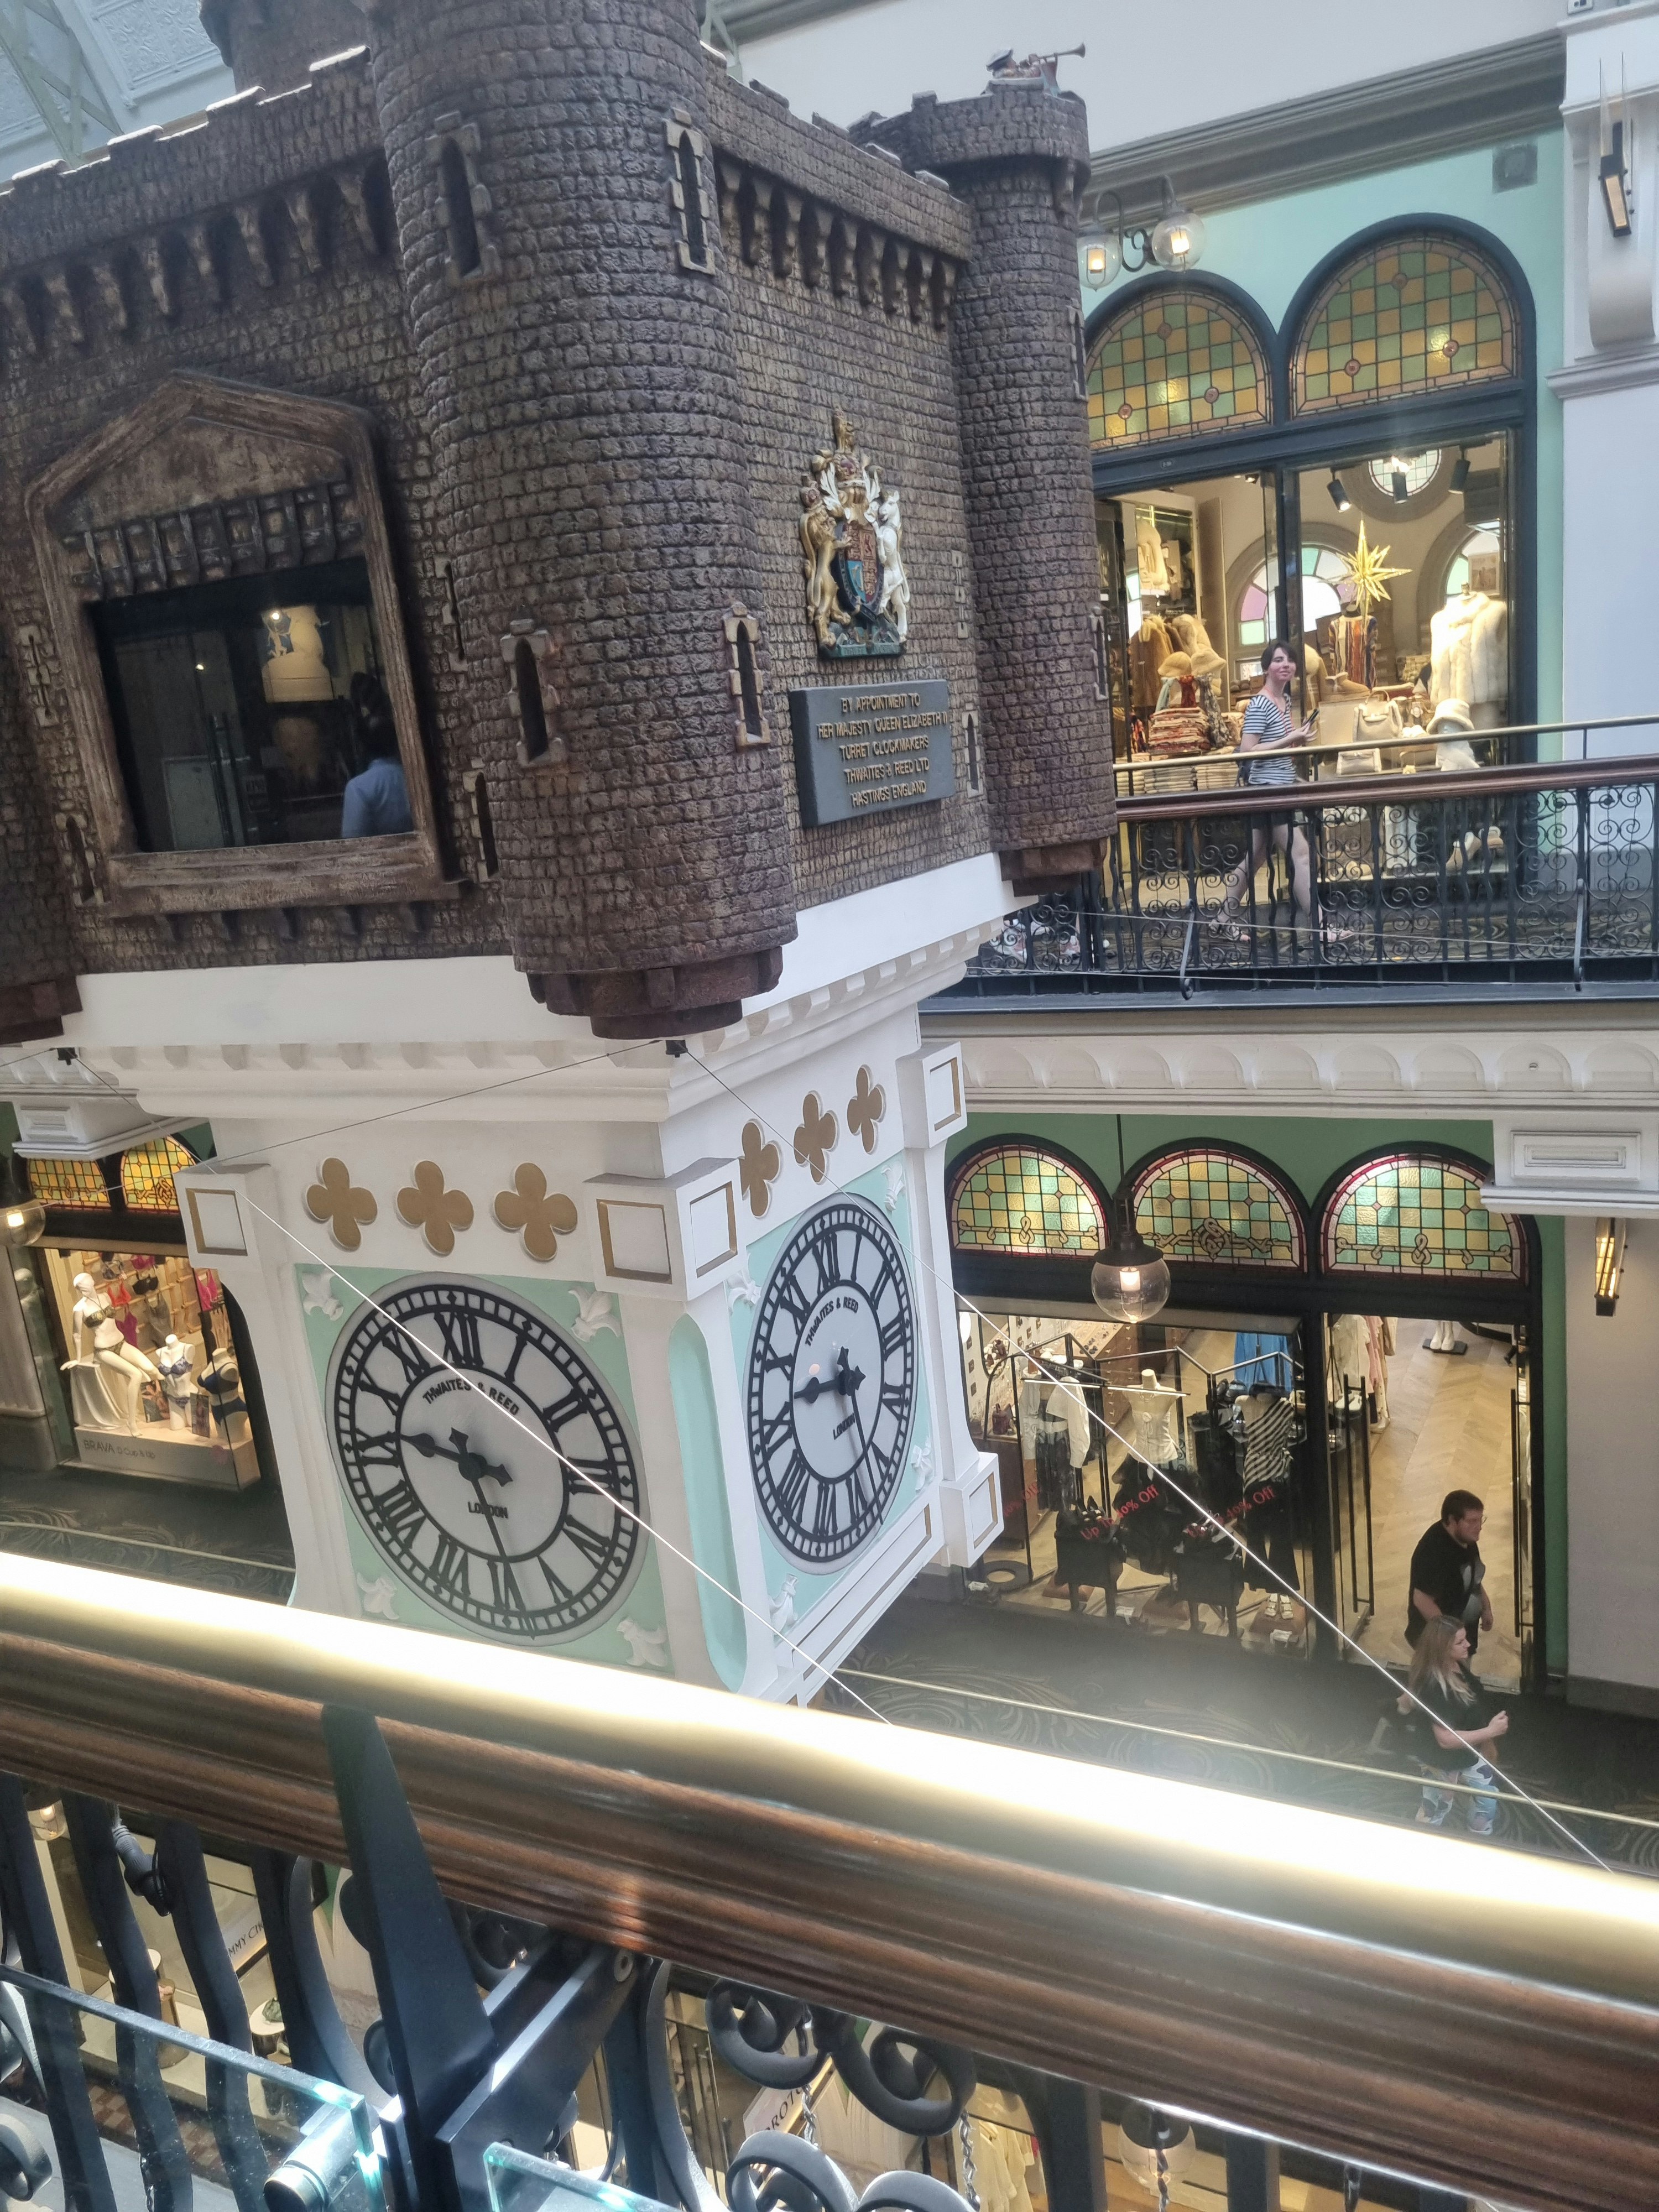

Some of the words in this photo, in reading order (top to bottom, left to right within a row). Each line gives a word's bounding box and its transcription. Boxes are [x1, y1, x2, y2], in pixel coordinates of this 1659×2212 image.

[841, 697, 853, 713] BY
[856, 693, 908, 711] APPOINTMENT
[909, 692, 921, 707] TO
[816, 723, 834, 739] HER
[835, 719, 873, 737] MAJESTY
[875, 716, 901, 733] QUEEN
[901, 712, 942, 729] ELIZABETH
[942, 711, 948, 725] II
[839, 742, 871, 761] TURRET
[872, 734, 930, 756] CLOCKMAKERS
[843, 764, 885, 784] THWAITES
[894, 760, 914, 775] REED
[914, 757, 930, 773] LTD
[850, 786, 890, 807] HASTINGS
[891, 780, 927, 799] ENGLAND
[805, 1300, 834, 1346] THWAITES
[843, 1296, 859, 1313] REED
[422, 1378, 471, 1405] THWAITES
[489, 1387, 520, 1416] REED
[833, 1412, 855, 1441] LONDON
[84, 1439, 116, 1454] BRAVA
[1253, 1486, 1275, 1504] Off
[467, 1501, 509, 1519] LODON
[1080, 1527, 1100, 1540] Up
[1138, 1484, 1160, 1503] Off
[228, 1934, 246, 1958] MMY
[248, 1921, 264, 1939] CH
[765, 2088, 802, 2131] ROT
